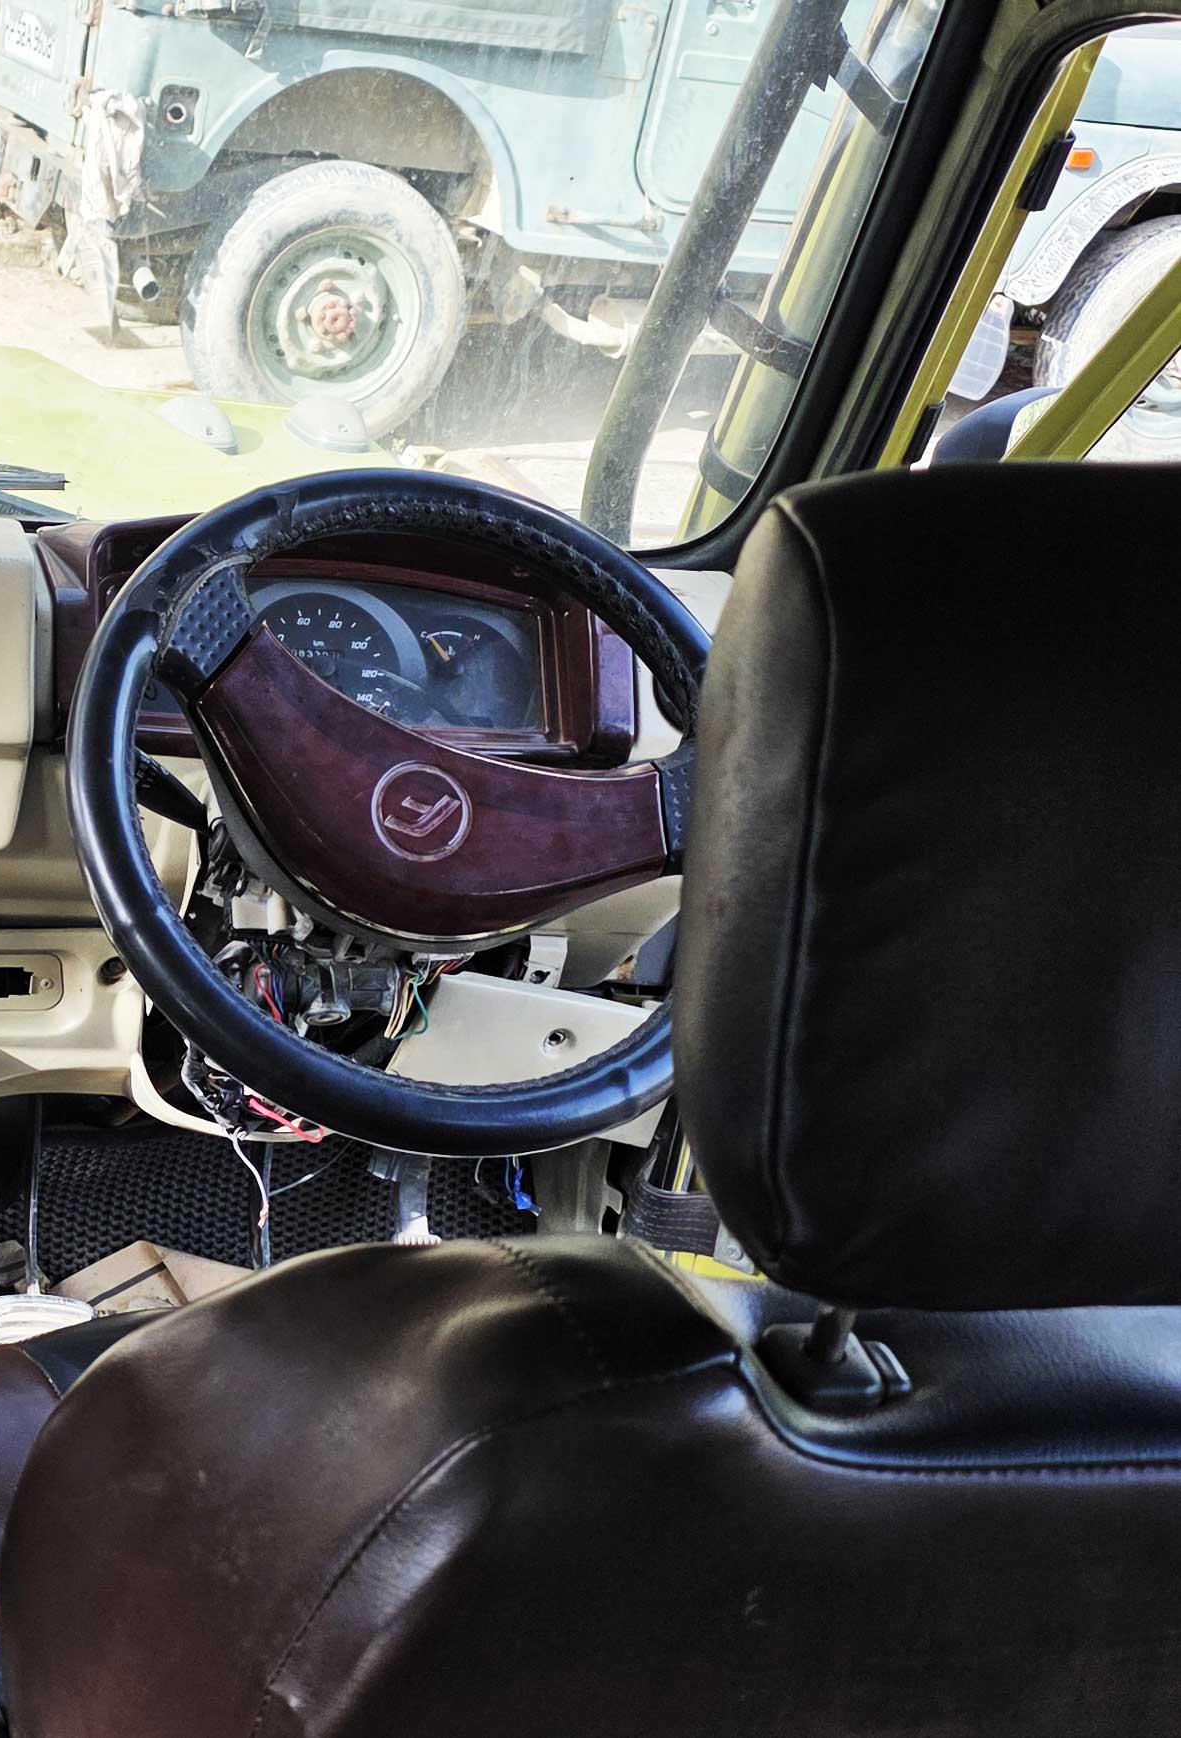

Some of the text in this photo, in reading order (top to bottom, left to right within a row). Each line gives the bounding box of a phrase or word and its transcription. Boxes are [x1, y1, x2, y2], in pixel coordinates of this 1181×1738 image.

[297, 617, 311, 626] 60
[328, 620, 343, 629] 80
[351, 641, 368, 649] 100
[361, 669, 378, 678] 120
[356, 693, 373, 702] 140
